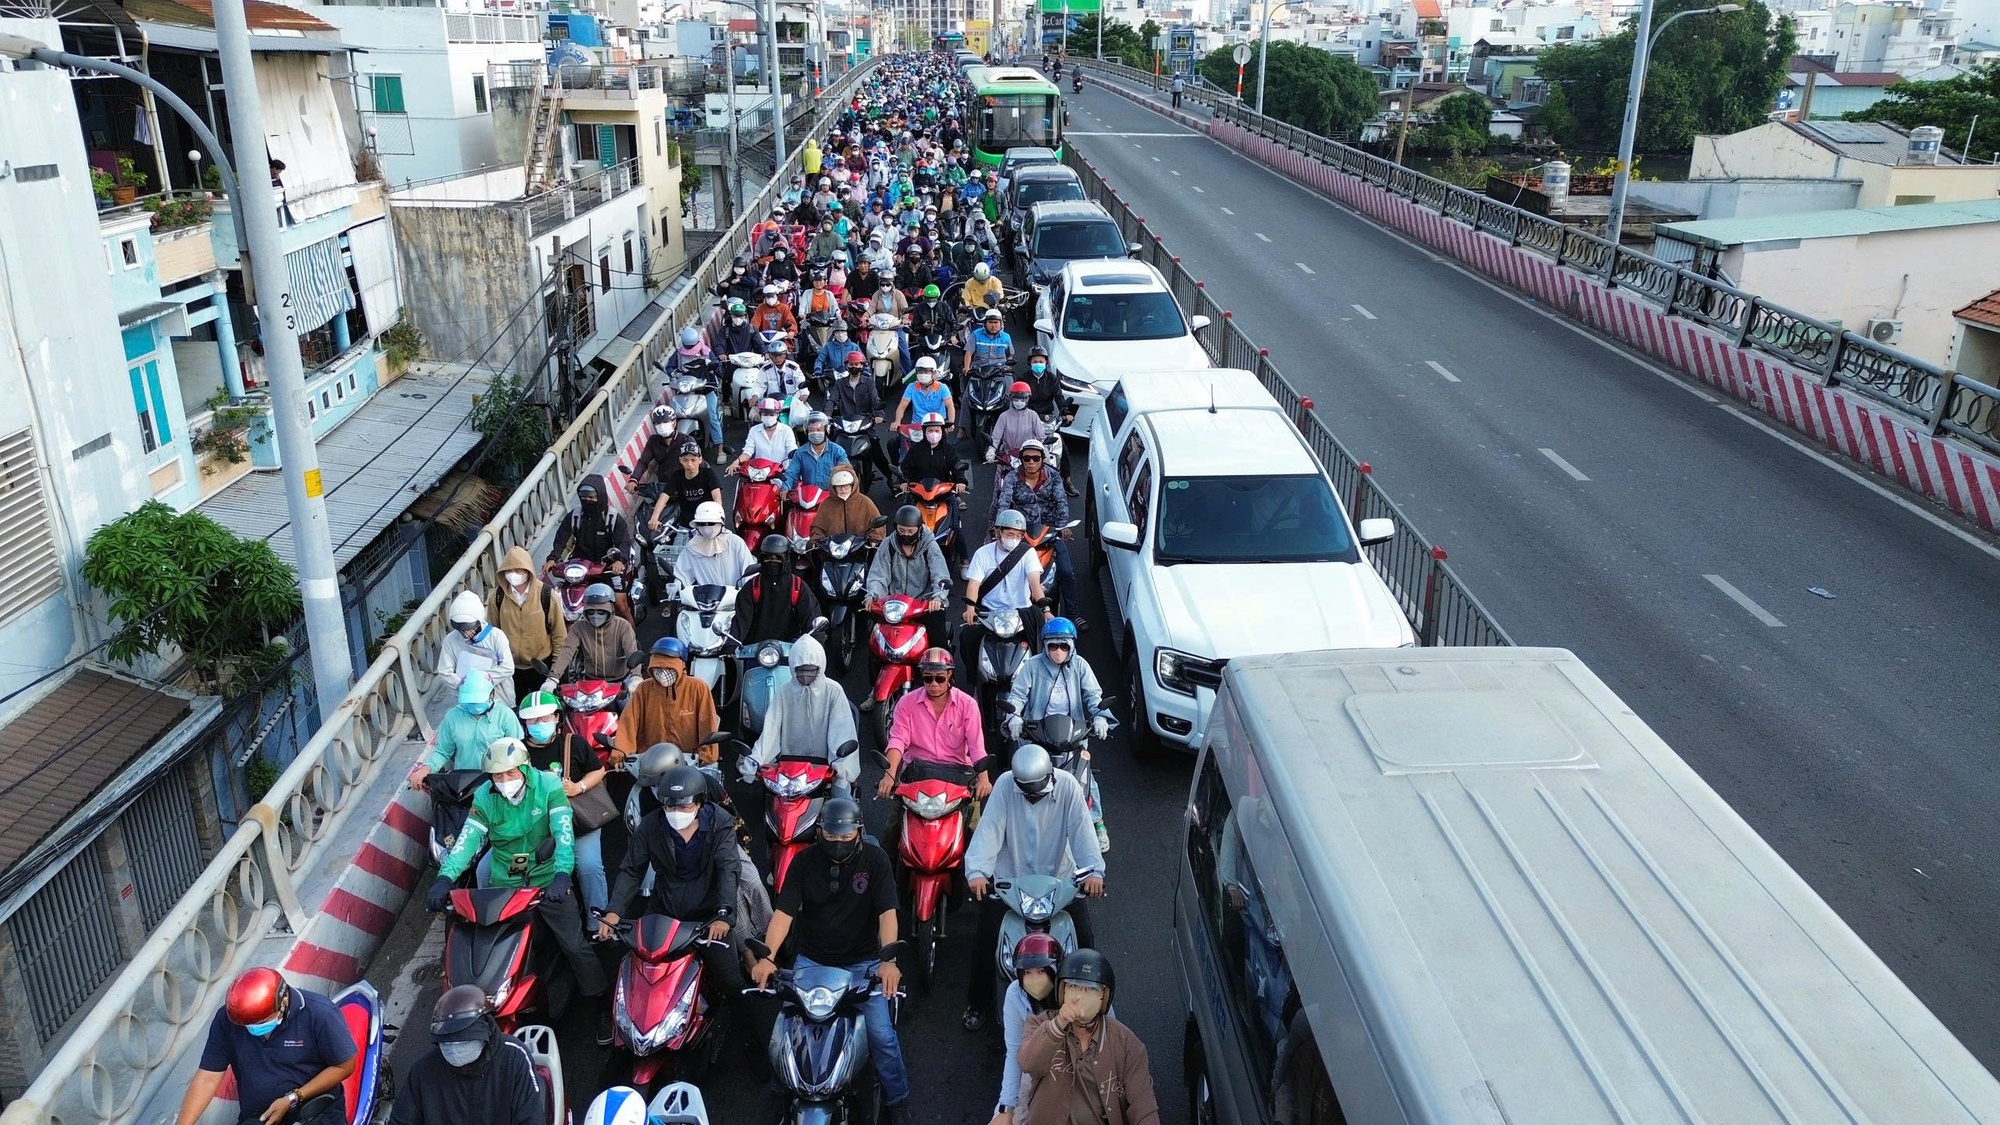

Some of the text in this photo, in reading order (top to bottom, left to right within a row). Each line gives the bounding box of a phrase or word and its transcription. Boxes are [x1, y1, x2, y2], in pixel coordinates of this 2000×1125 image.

[1780, 91, 1789, 99] P
[984, 96, 995, 106] 72
[531, 807, 543, 816] ab
[558, 814, 572, 846] Grab
